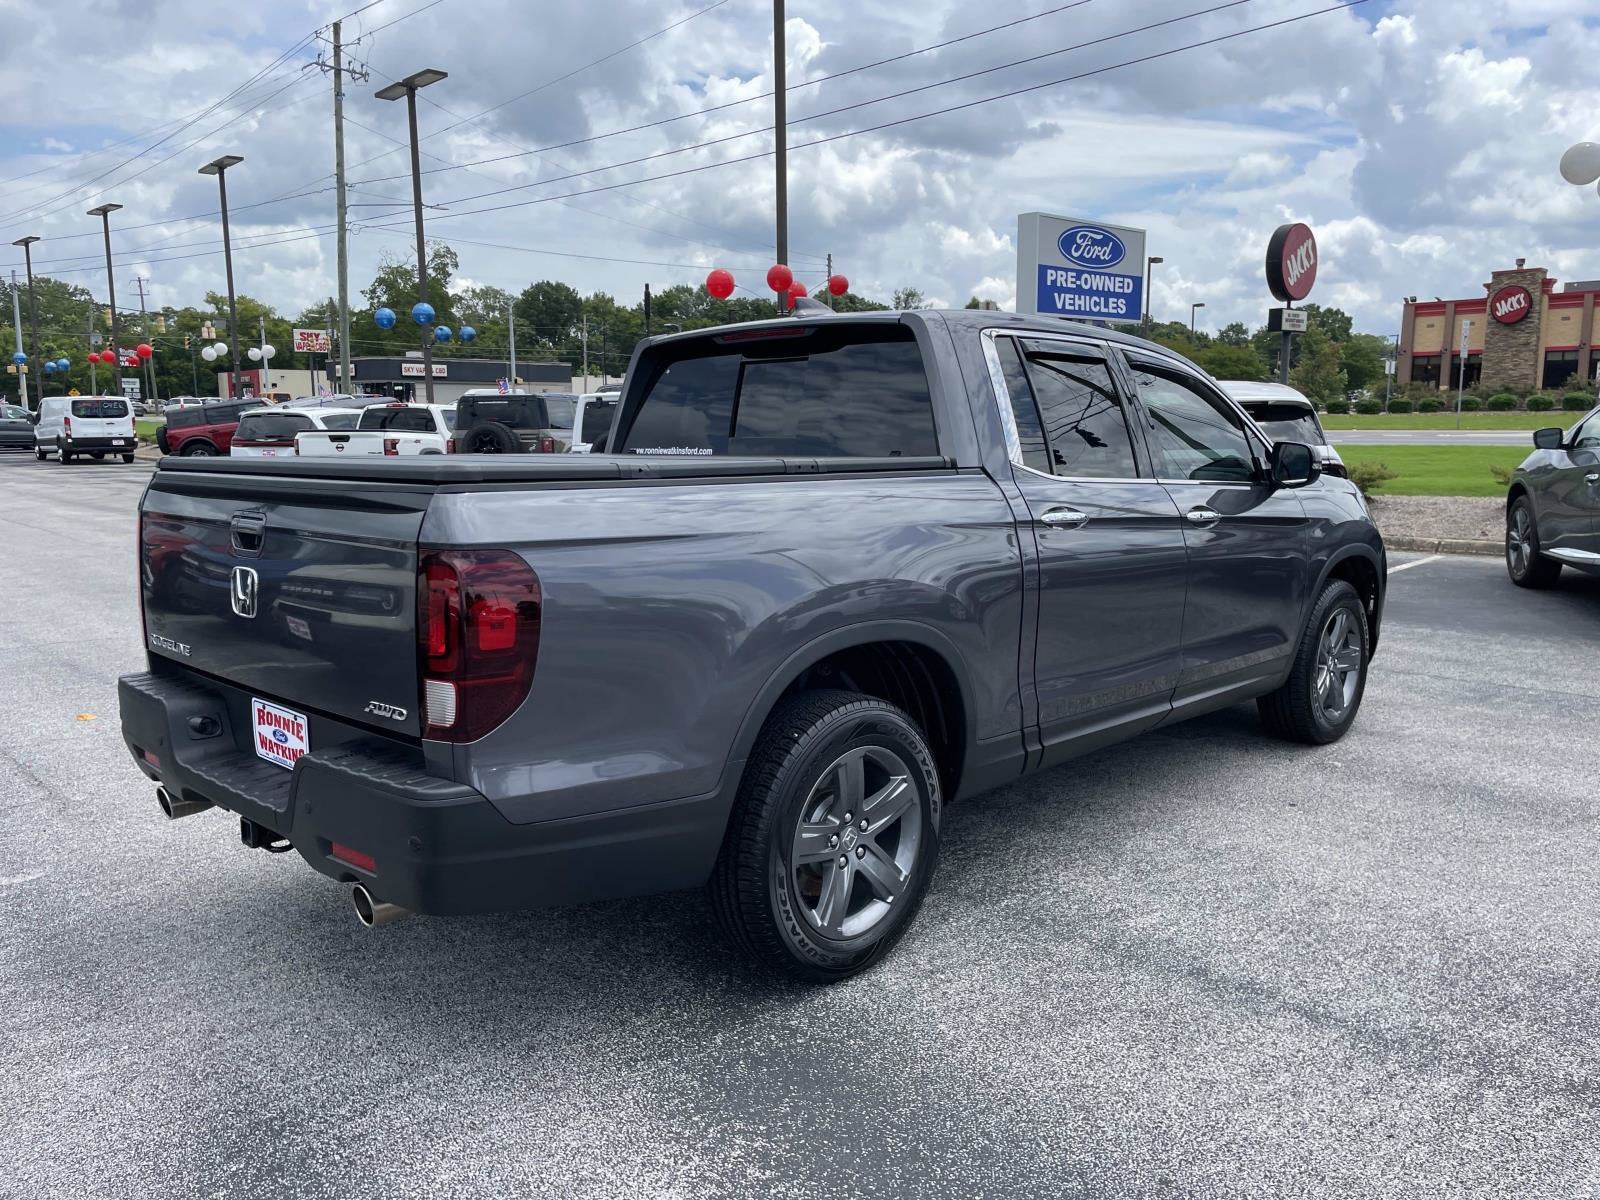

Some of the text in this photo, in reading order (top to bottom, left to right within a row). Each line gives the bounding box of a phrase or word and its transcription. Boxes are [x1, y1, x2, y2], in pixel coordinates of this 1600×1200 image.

[1071, 231, 1113, 260] Ford
[1046, 268, 1134, 294] PRE-OWNED
[1053, 292, 1127, 315] VEHICLES
[299, 331, 321, 342] SKY
[403, 366, 415, 374] SKY
[364, 700, 407, 721] AWD
[257, 707, 304, 744] RONNIE
